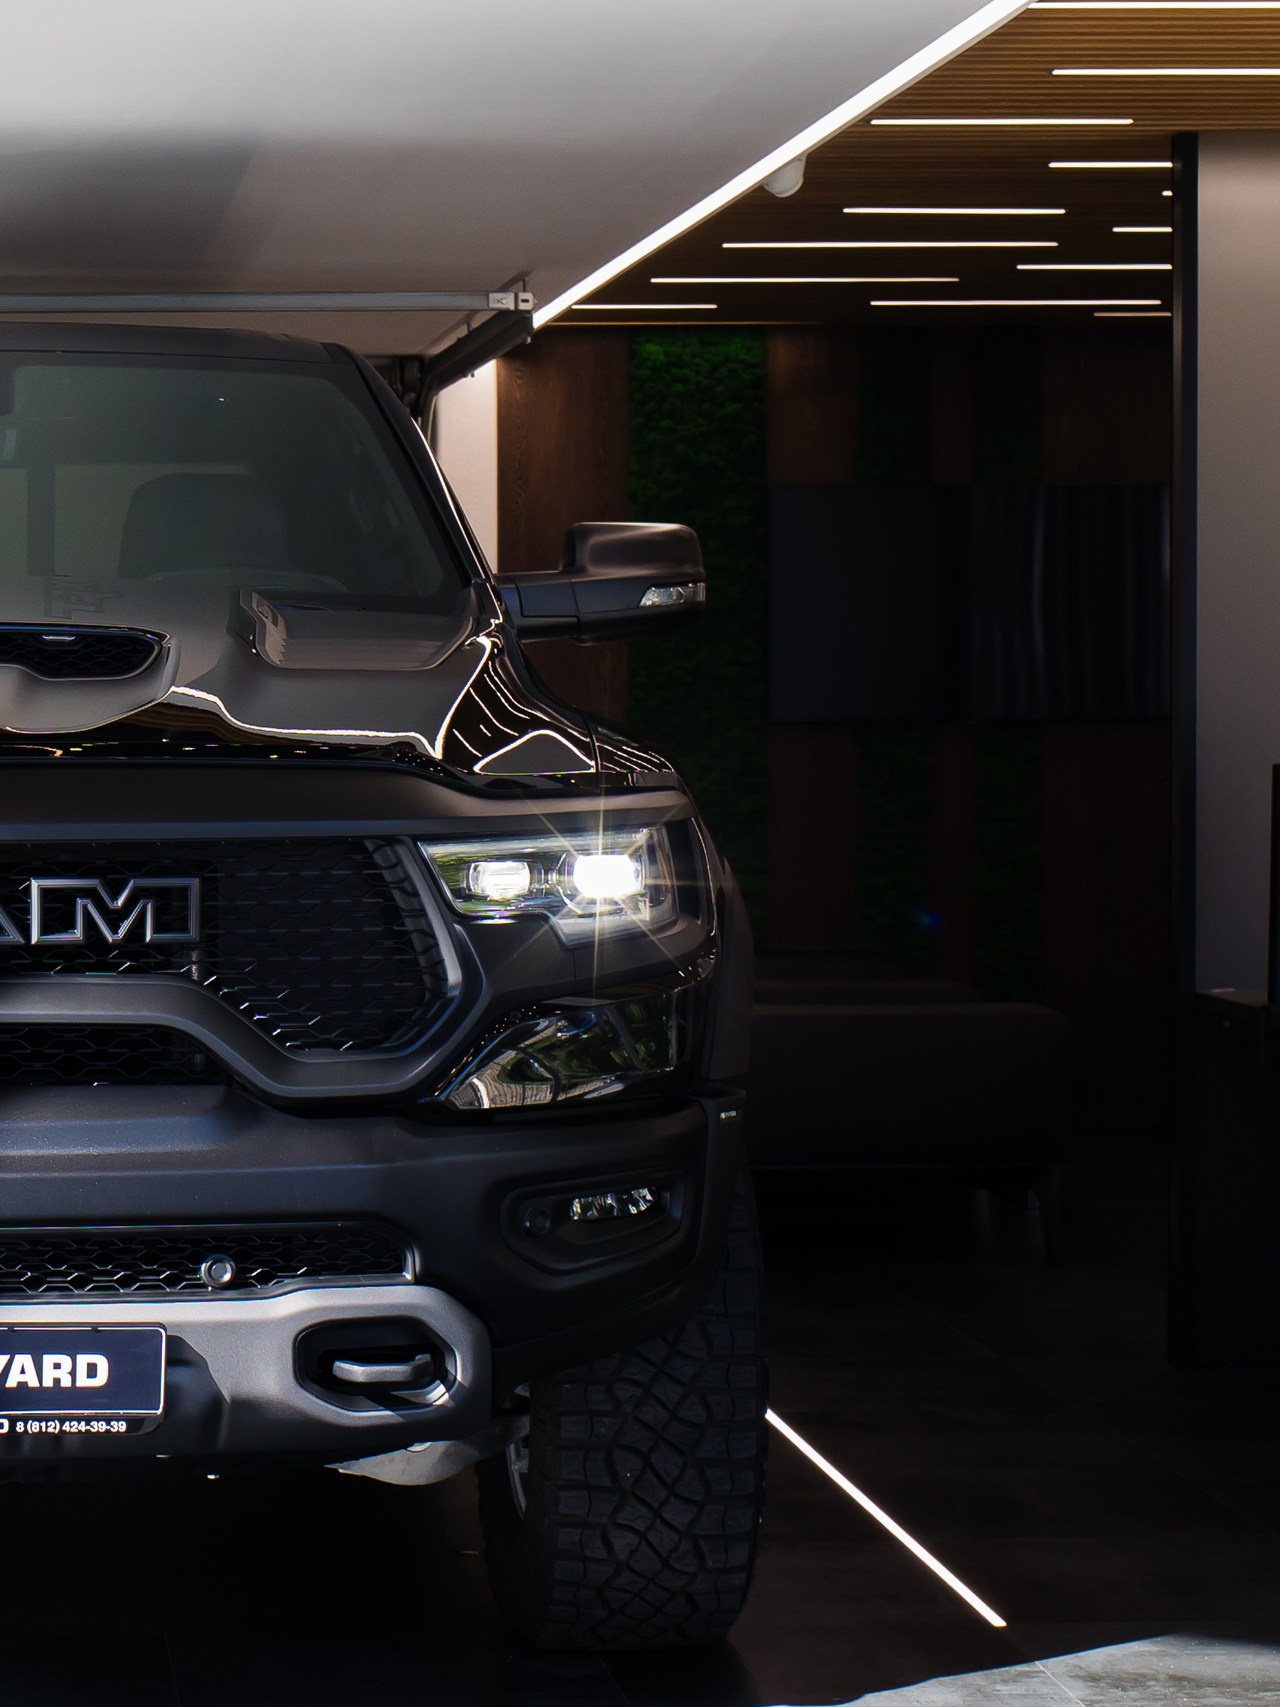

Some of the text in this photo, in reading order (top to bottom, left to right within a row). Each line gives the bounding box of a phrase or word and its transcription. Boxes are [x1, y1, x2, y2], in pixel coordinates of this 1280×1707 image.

[15, 1420, 25, 1433] 8
[26, 1419, 60, 1434] (812)
[61, 1420, 127, 1433] 424-39-39
